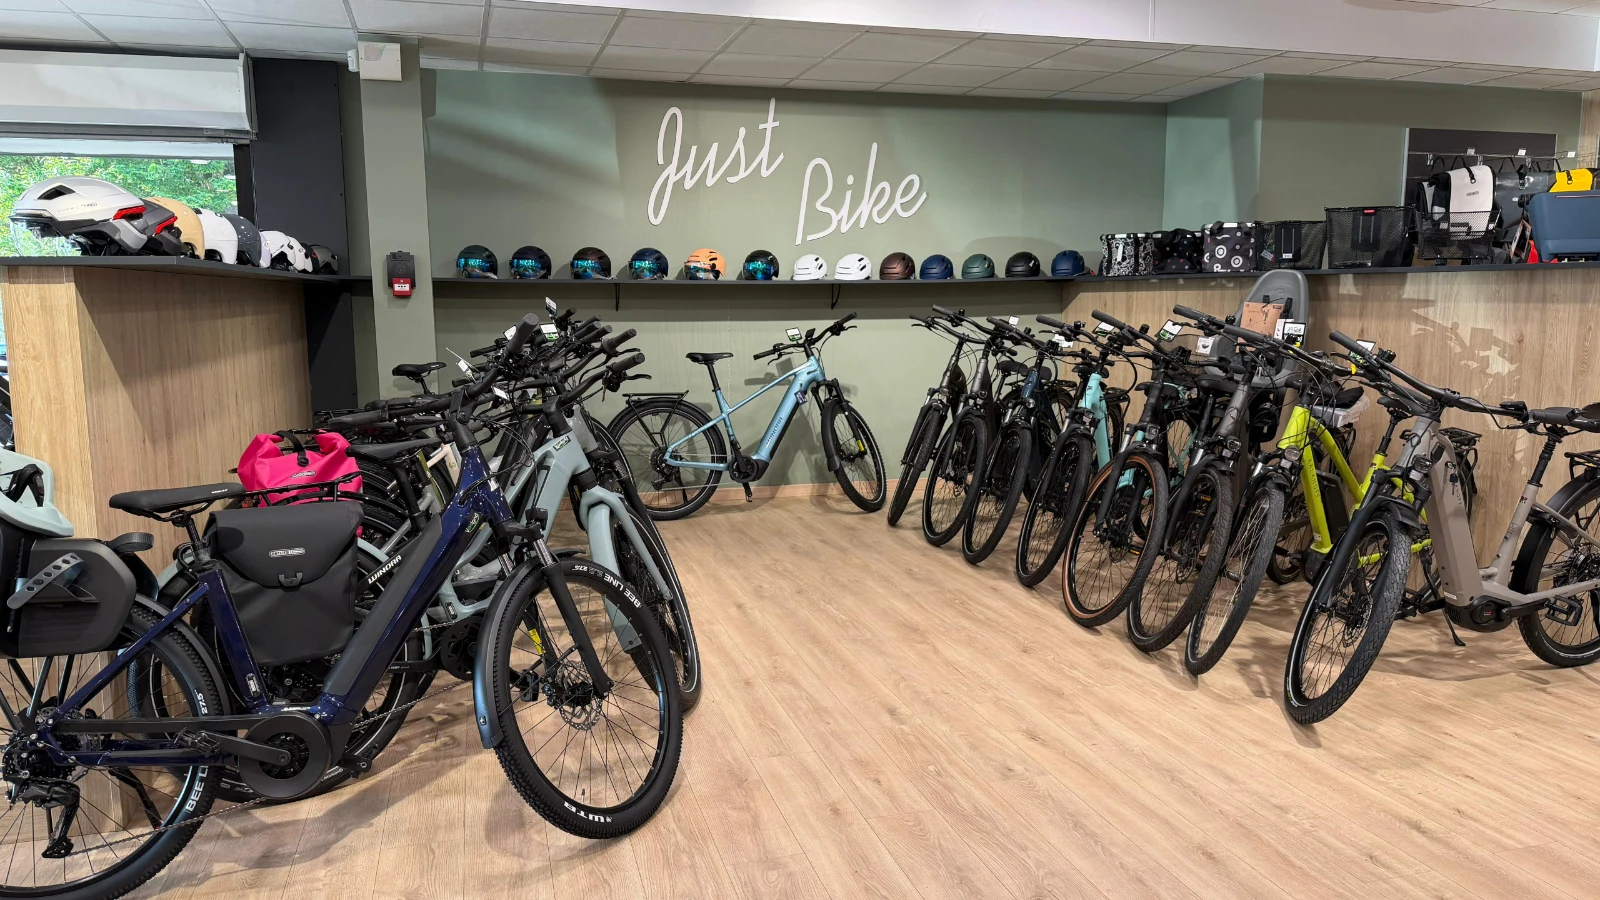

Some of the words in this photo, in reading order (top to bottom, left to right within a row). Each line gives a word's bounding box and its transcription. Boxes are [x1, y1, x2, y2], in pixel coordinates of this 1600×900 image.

[647, 97, 784, 225] Just
[795, 142, 928, 245] Bike
[368, 554, 402, 585] WINORA
[603, 573, 624, 591] LINE
[623, 588, 642, 609] BEE
[185, 781, 205, 812] BEE
[199, 765, 209, 777] LI
